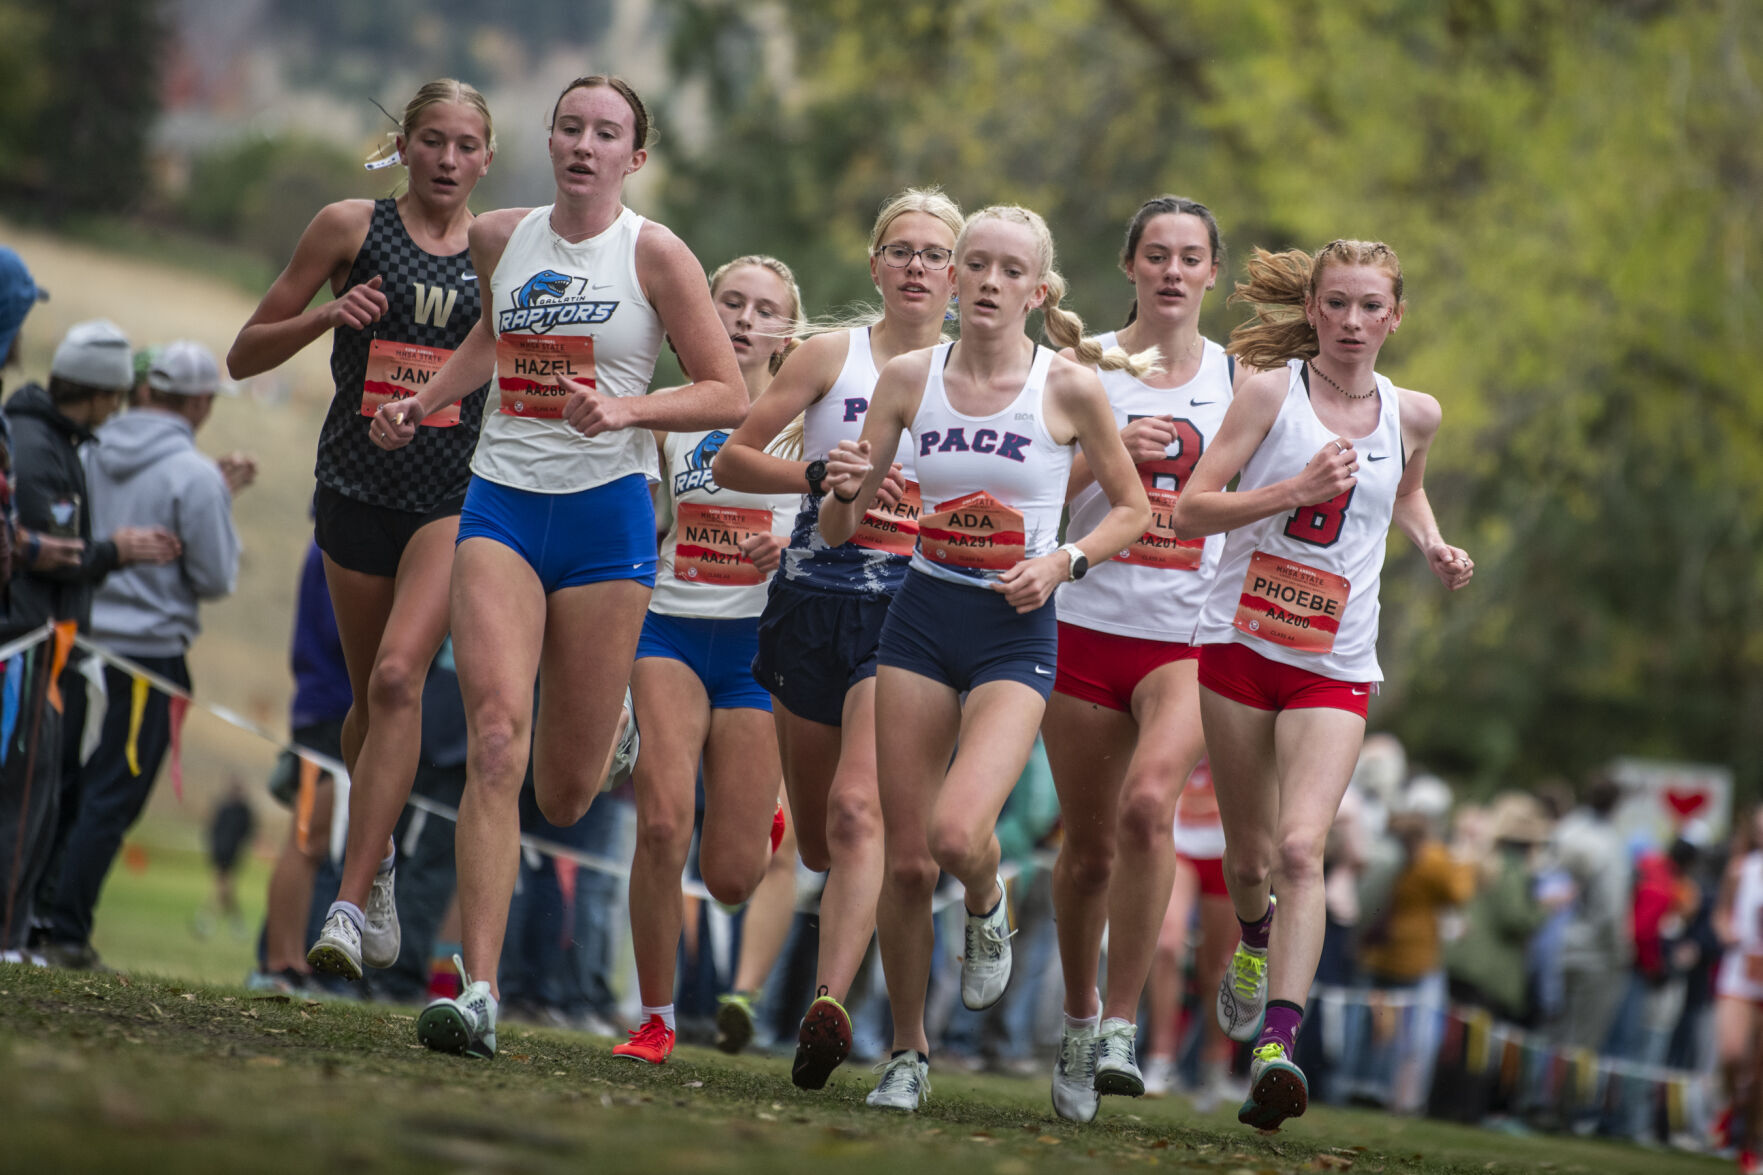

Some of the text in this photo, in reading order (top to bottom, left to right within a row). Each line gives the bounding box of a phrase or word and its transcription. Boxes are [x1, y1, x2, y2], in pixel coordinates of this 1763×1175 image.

[413, 282, 458, 328] W
[540, 296, 586, 305] GALLATIN
[500, 302, 619, 333] RAPTORS
[391, 366, 441, 385] JAN
[515, 358, 578, 376] HAZEL
[920, 428, 1033, 463] PACK
[948, 512, 995, 529] ADA
[948, 536, 994, 548] AA291
[701, 551, 740, 566] AA271
[1253, 577, 1338, 615] PHOEBE
[1265, 607, 1310, 629] AA200
